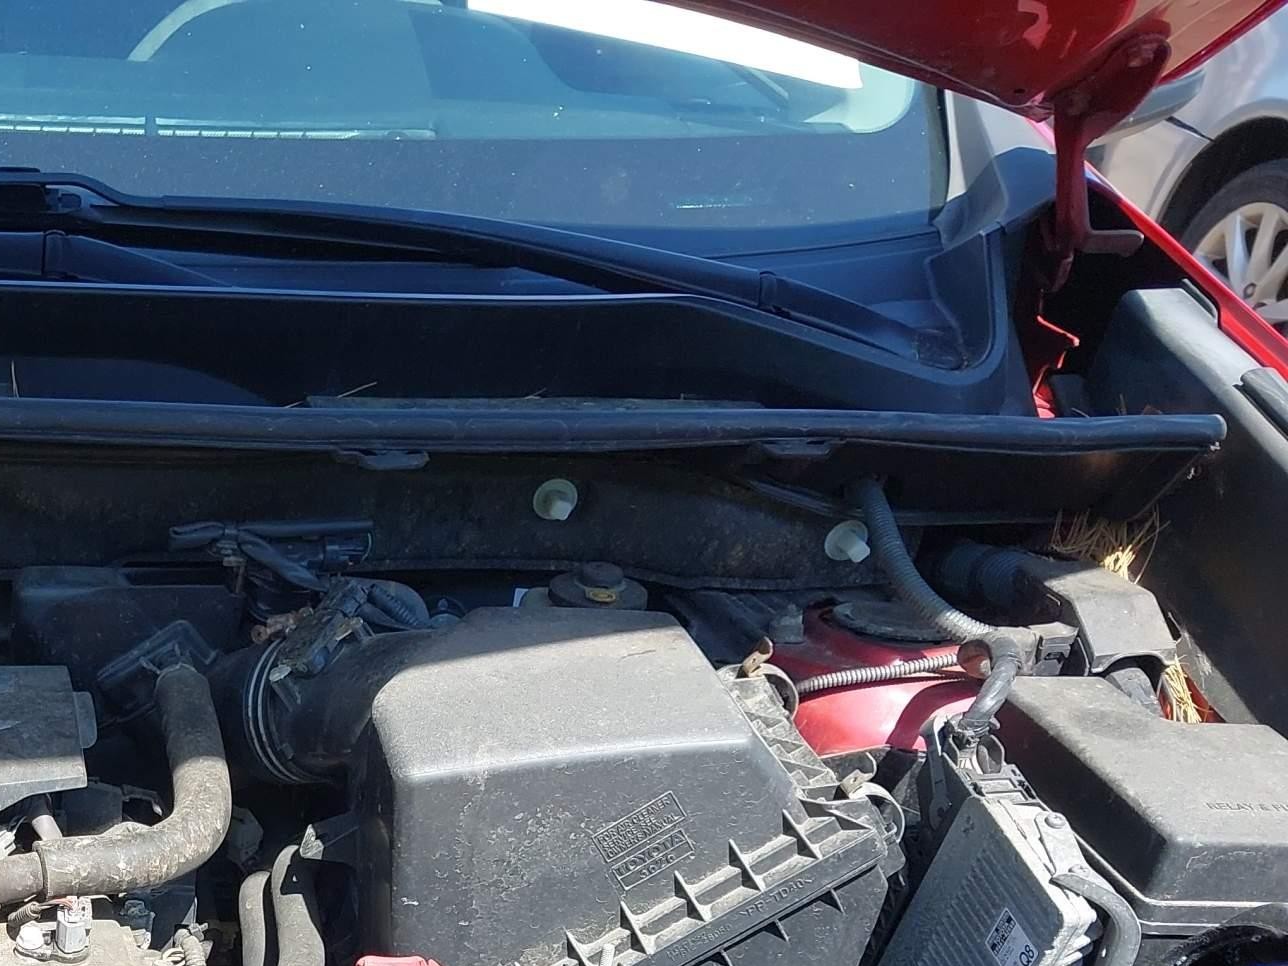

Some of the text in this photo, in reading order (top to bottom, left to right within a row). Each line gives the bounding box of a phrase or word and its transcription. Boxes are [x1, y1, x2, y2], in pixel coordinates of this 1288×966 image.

[1205, 801, 1252, 812] RELAY
[597, 797, 671, 845] FOR AIR CLEANER
[639, 817, 657, 829] SEE
[643, 813, 681, 838] MANUAL
[615, 832, 686, 876] TOYOTA
[1018, 944, 1035, 966] Q8
